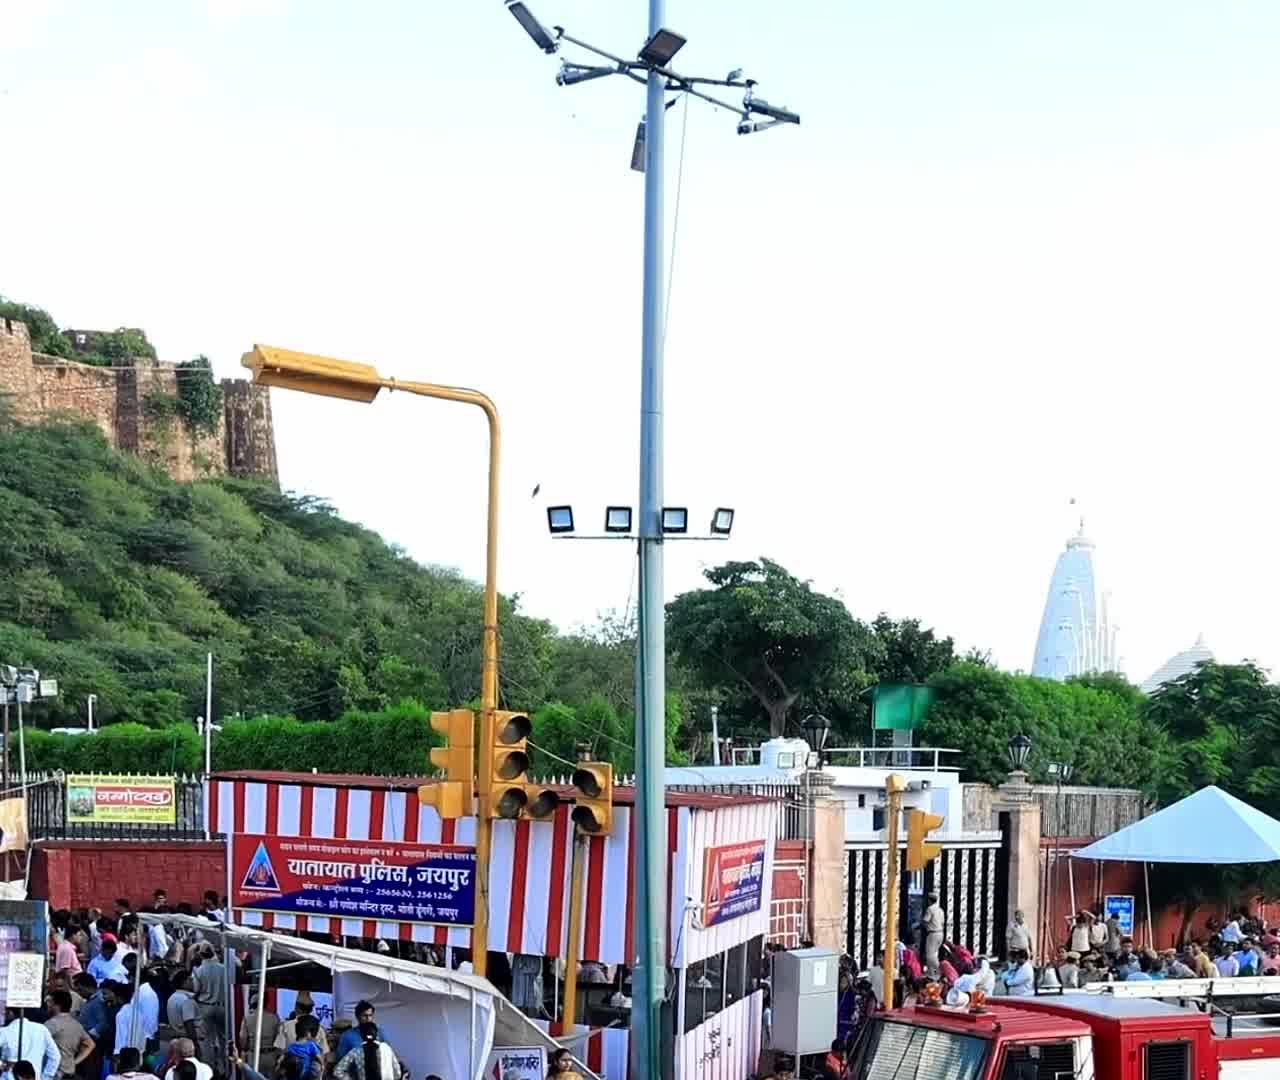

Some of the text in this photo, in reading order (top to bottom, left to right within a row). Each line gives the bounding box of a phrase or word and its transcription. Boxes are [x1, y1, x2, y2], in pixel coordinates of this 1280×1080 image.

[287, 857, 470, 891] यातायात पुलिस, जयपुर
[416, 889, 453, 900] 2561256
[436, 908, 459, 920] जयपुर
